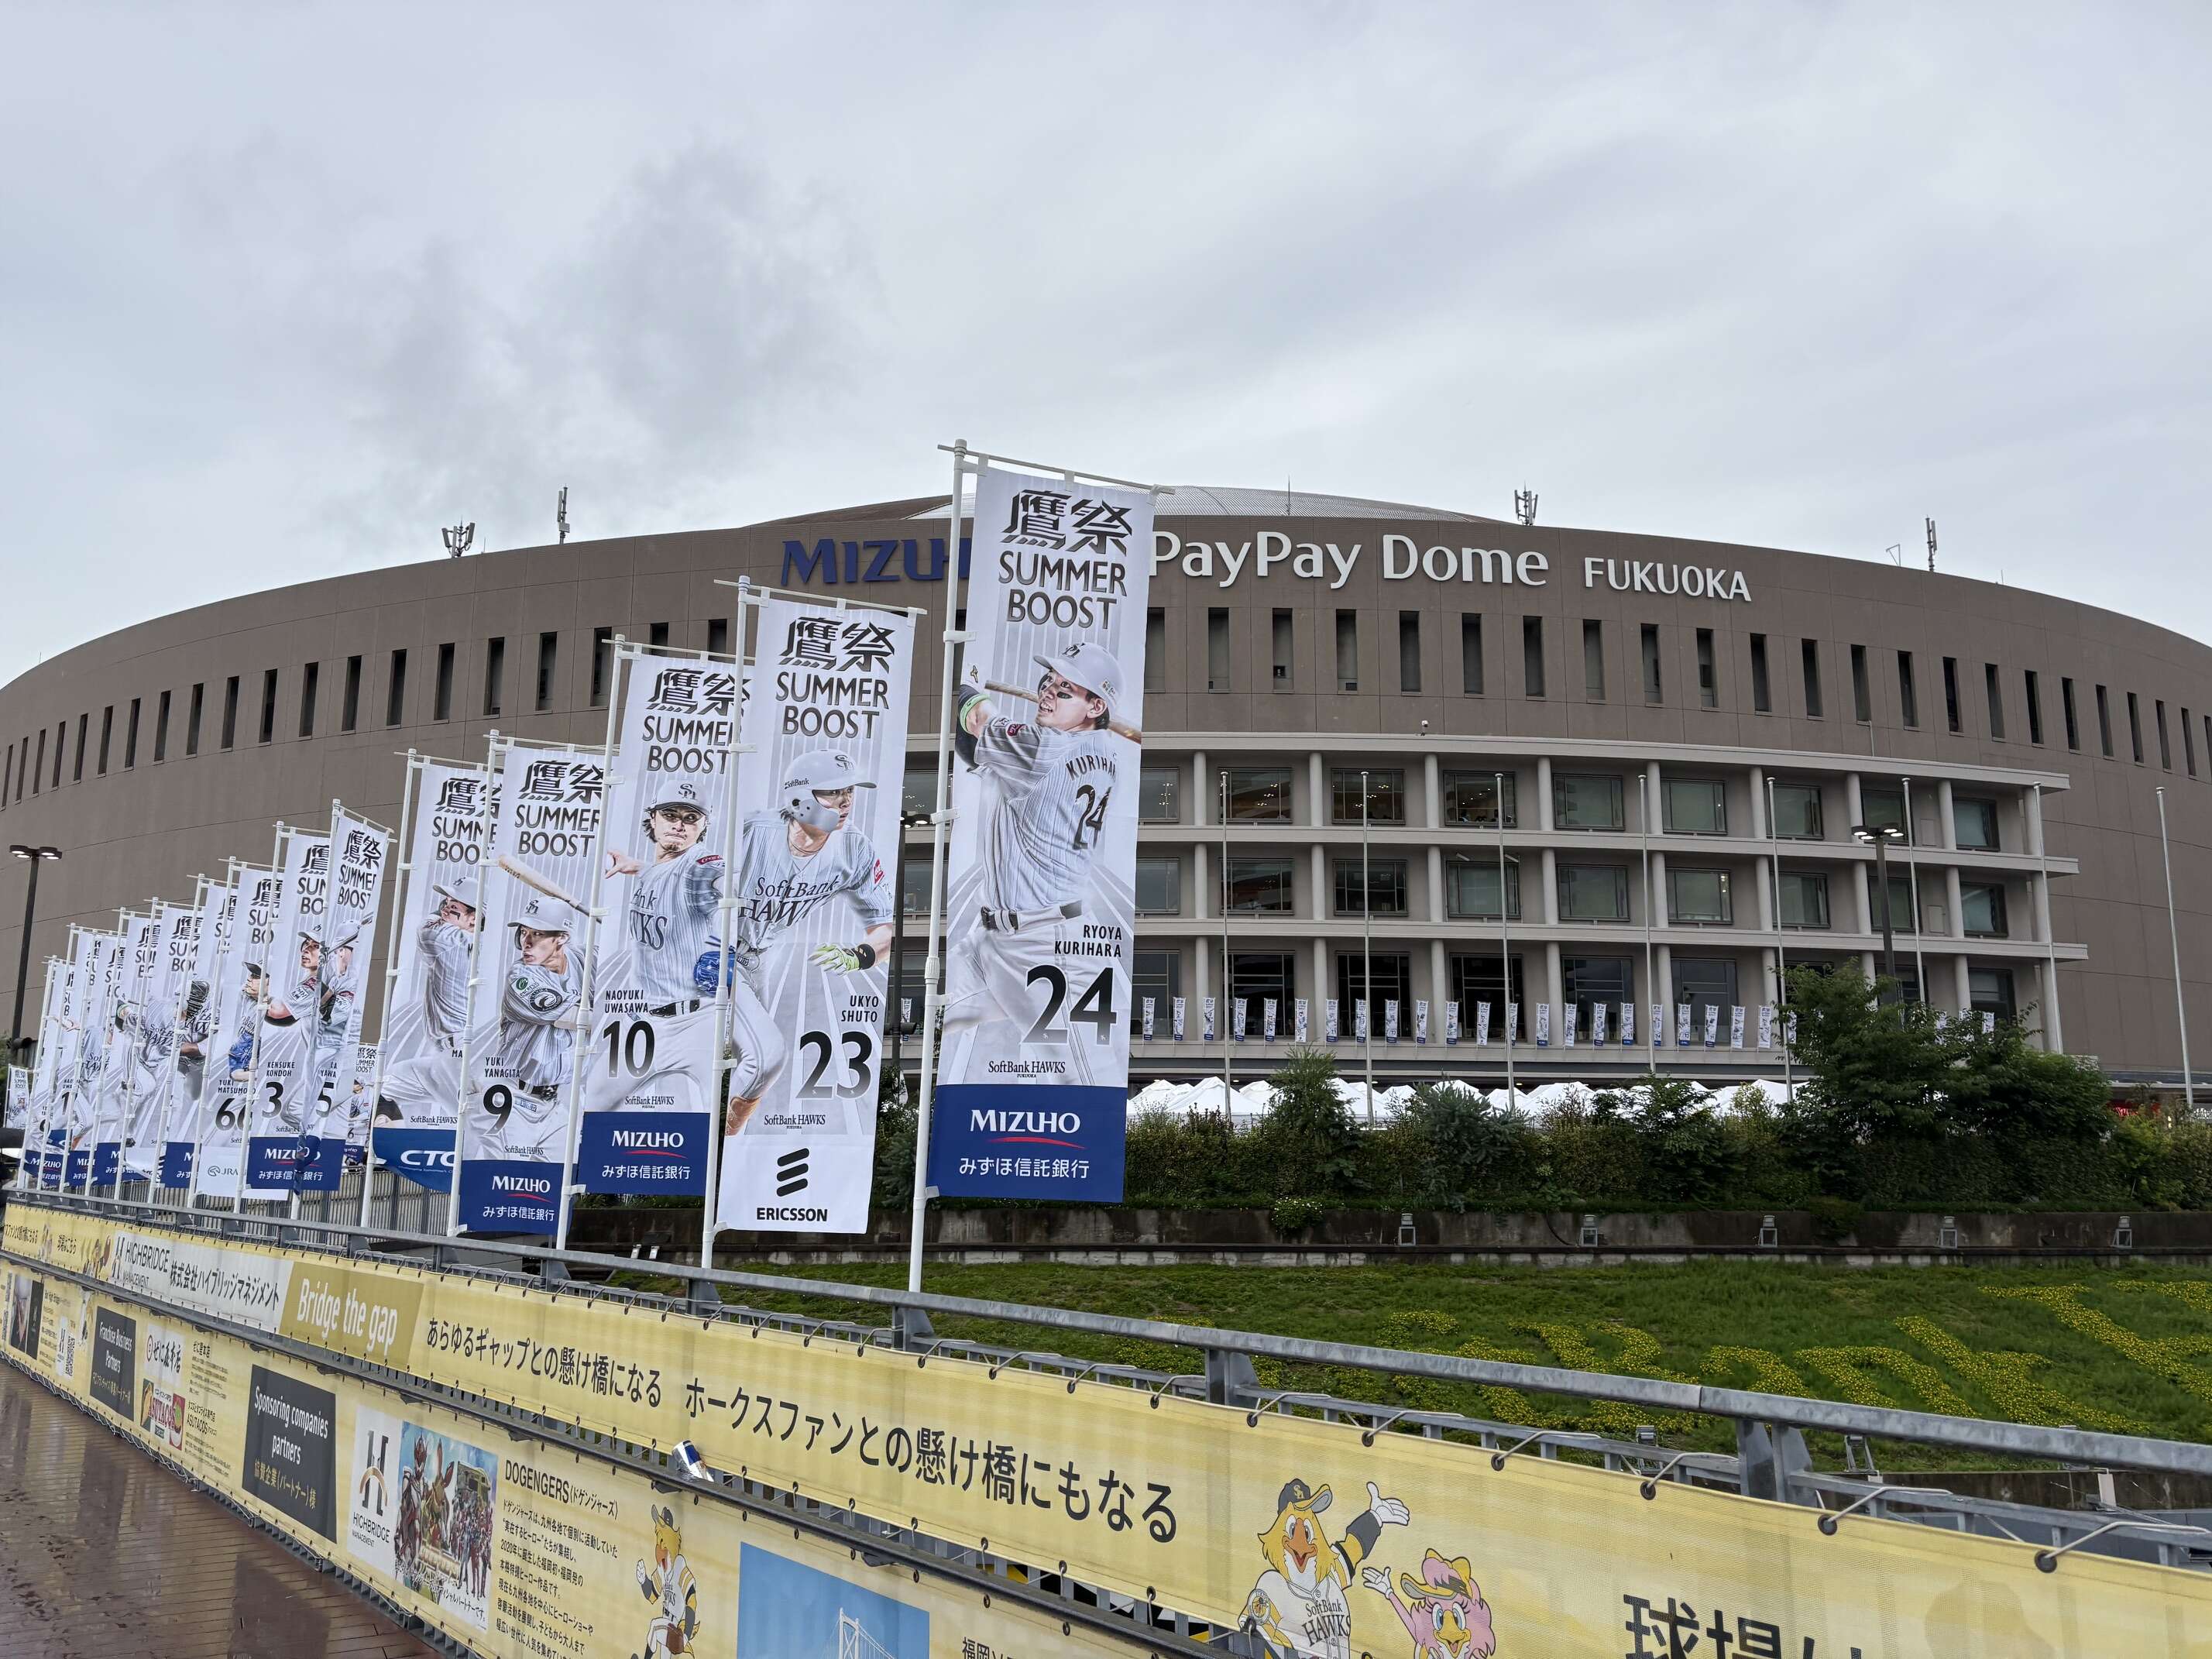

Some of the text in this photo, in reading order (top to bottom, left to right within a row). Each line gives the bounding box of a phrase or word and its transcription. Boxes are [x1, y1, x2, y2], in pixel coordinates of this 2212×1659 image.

[1001, 489, 1132, 556] 鷹祭
[780, 531, 1548, 589] MIZUH PayPay Dome
[998, 550, 1127, 596] SUMMER
[1585, 557, 1752, 603] FUKUOKA
[1007, 589, 1117, 629] BOOST
[778, 617, 895, 673] 鷹祭
[775, 672, 890, 710] SUMMER
[782, 706, 880, 739] BOOST
[647, 745, 730, 775] BOOST
[785, 778, 809, 789] SoftBank
[518, 831, 595, 857] BOOST
[755, 875, 839, 898] SoftBank
[1084, 925, 1122, 941] RYOYA
[1054, 940, 1122, 958] KURIHARA
[605, 990, 644, 1001] NAOYUKI
[850, 995, 880, 1008] UKYO
[1020, 964, 1117, 1046] 24
[605, 1003, 649, 1014] UWASAWA
[841, 1010, 878, 1023] SHUTO
[486, 1056, 504, 1066] YUKI
[603, 1020, 655, 1079] 10
[267, 1061, 295, 1070] KENSUKE
[484, 1069, 520, 1079] YANAGITA
[795, 1029, 874, 1099] 23
[988, 1060, 1066, 1074] SoftBank HAWKS
[262, 1081, 284, 1118] 3
[316, 1081, 335, 1118] 5
[483, 1084, 513, 1136] 9
[625, 1096, 675, 1105] SoftBank HAWKS
[764, 1115, 826, 1125] SoftBank HAWKS
[970, 1109, 1080, 1134] MIZUHO
[504, 1146, 544, 1155] SoftBank HAWKS
[612, 1130, 684, 1148] MIZUHO
[258, 1170, 324, 1181] みずほ信銀行
[602, 1165, 691, 1180] みずほ信託銀行
[959, 1156, 1090, 1179] みずほ信託銀行
[492, 1176, 551, 1194] MIZUHO
[483, 1206, 555, 1221] みずほ信託銀行
[756, 1207, 828, 1222] ERICSSON
[125, 1242, 170, 1274] HIGHBRIDGE
[297, 1277, 398, 1356] Bridge the gap
[427, 1317, 661, 1408] あらゆるギャップとの懸け橋になる
[254, 1386, 329, 1440] Sponsoring companies
[272, 1434, 301, 1465] partners
[685, 1377, 1177, 1544] ホークスファンとの懸け橋にもなる
[352, 1511, 390, 1544] HIGHBRIDGE
[1305, 1598, 1344, 1617] SoftBank
